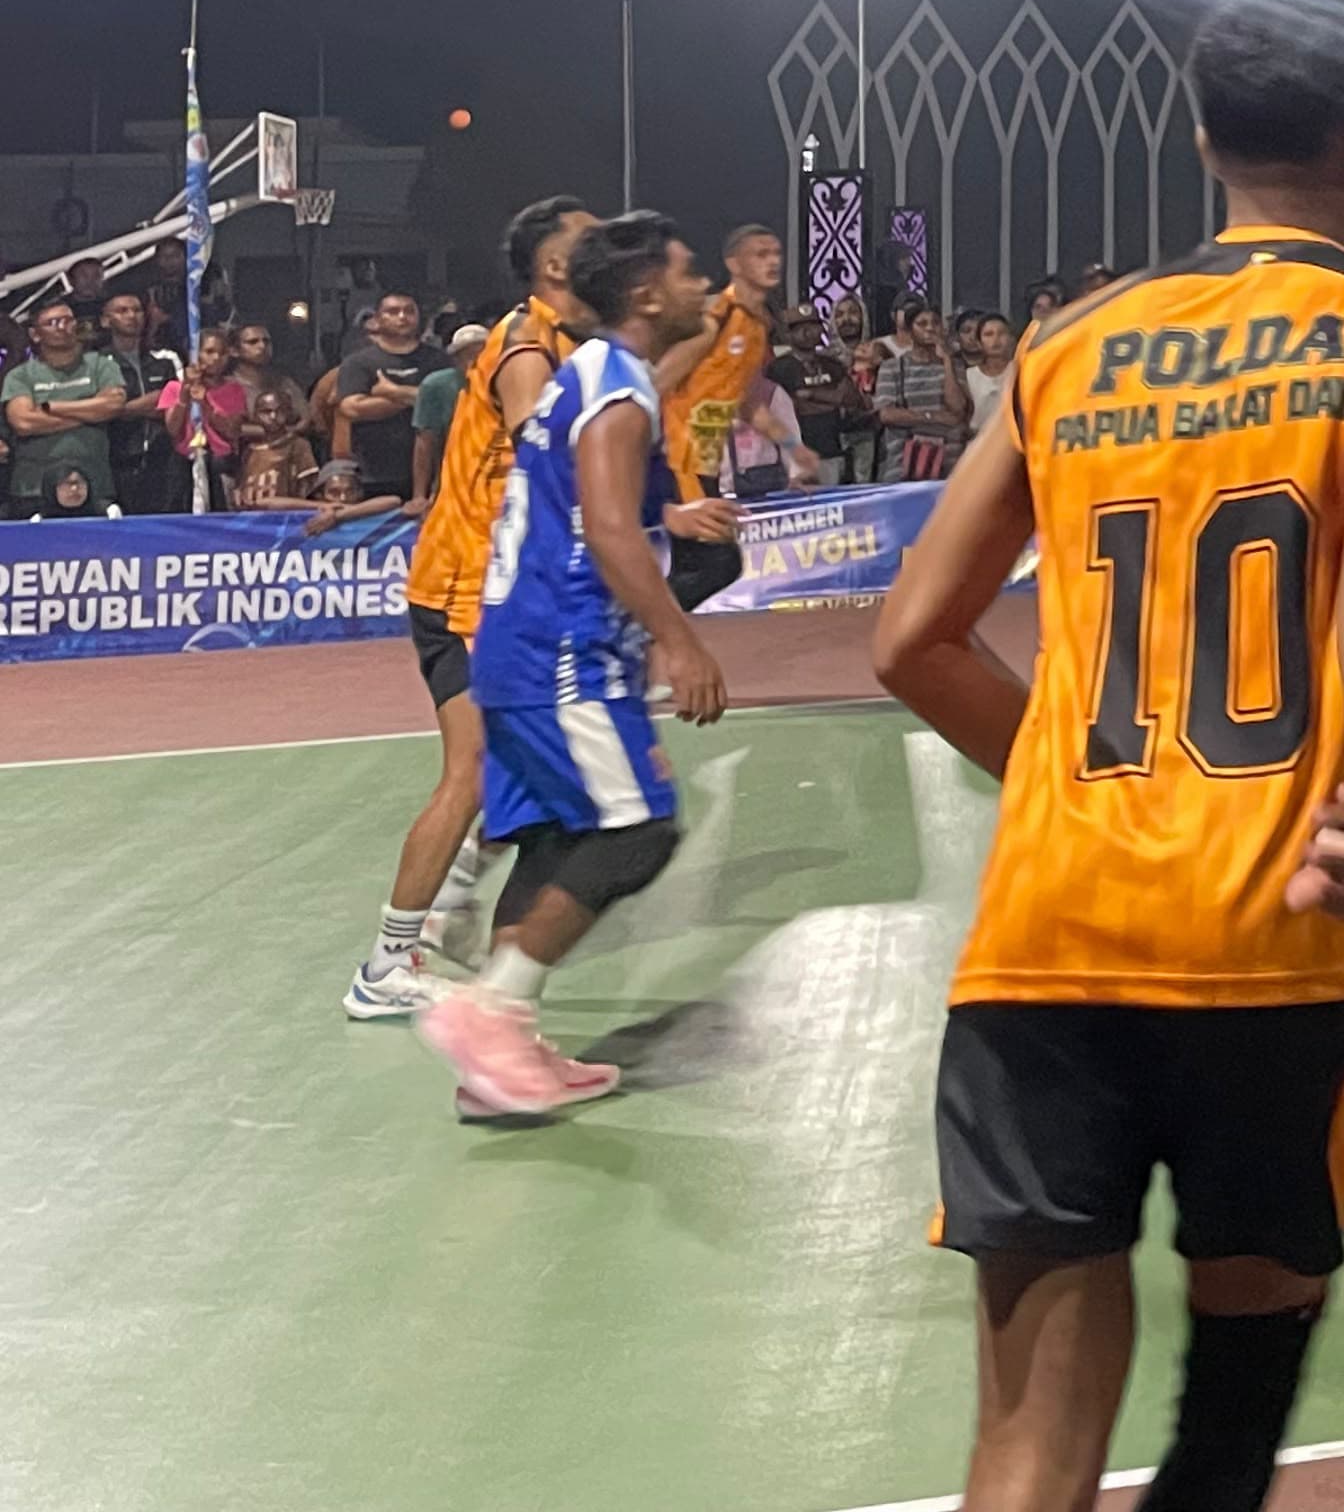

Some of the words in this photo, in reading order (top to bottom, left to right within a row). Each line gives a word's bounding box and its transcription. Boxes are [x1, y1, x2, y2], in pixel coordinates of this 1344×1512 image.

[737, 505, 845, 544] RNAMEN
[156, 545, 409, 588] PERWAKILA
[791, 524, 878, 569] VOLI
[215, 583, 410, 624] INDONES
[1074, 477, 1321, 782] 10
